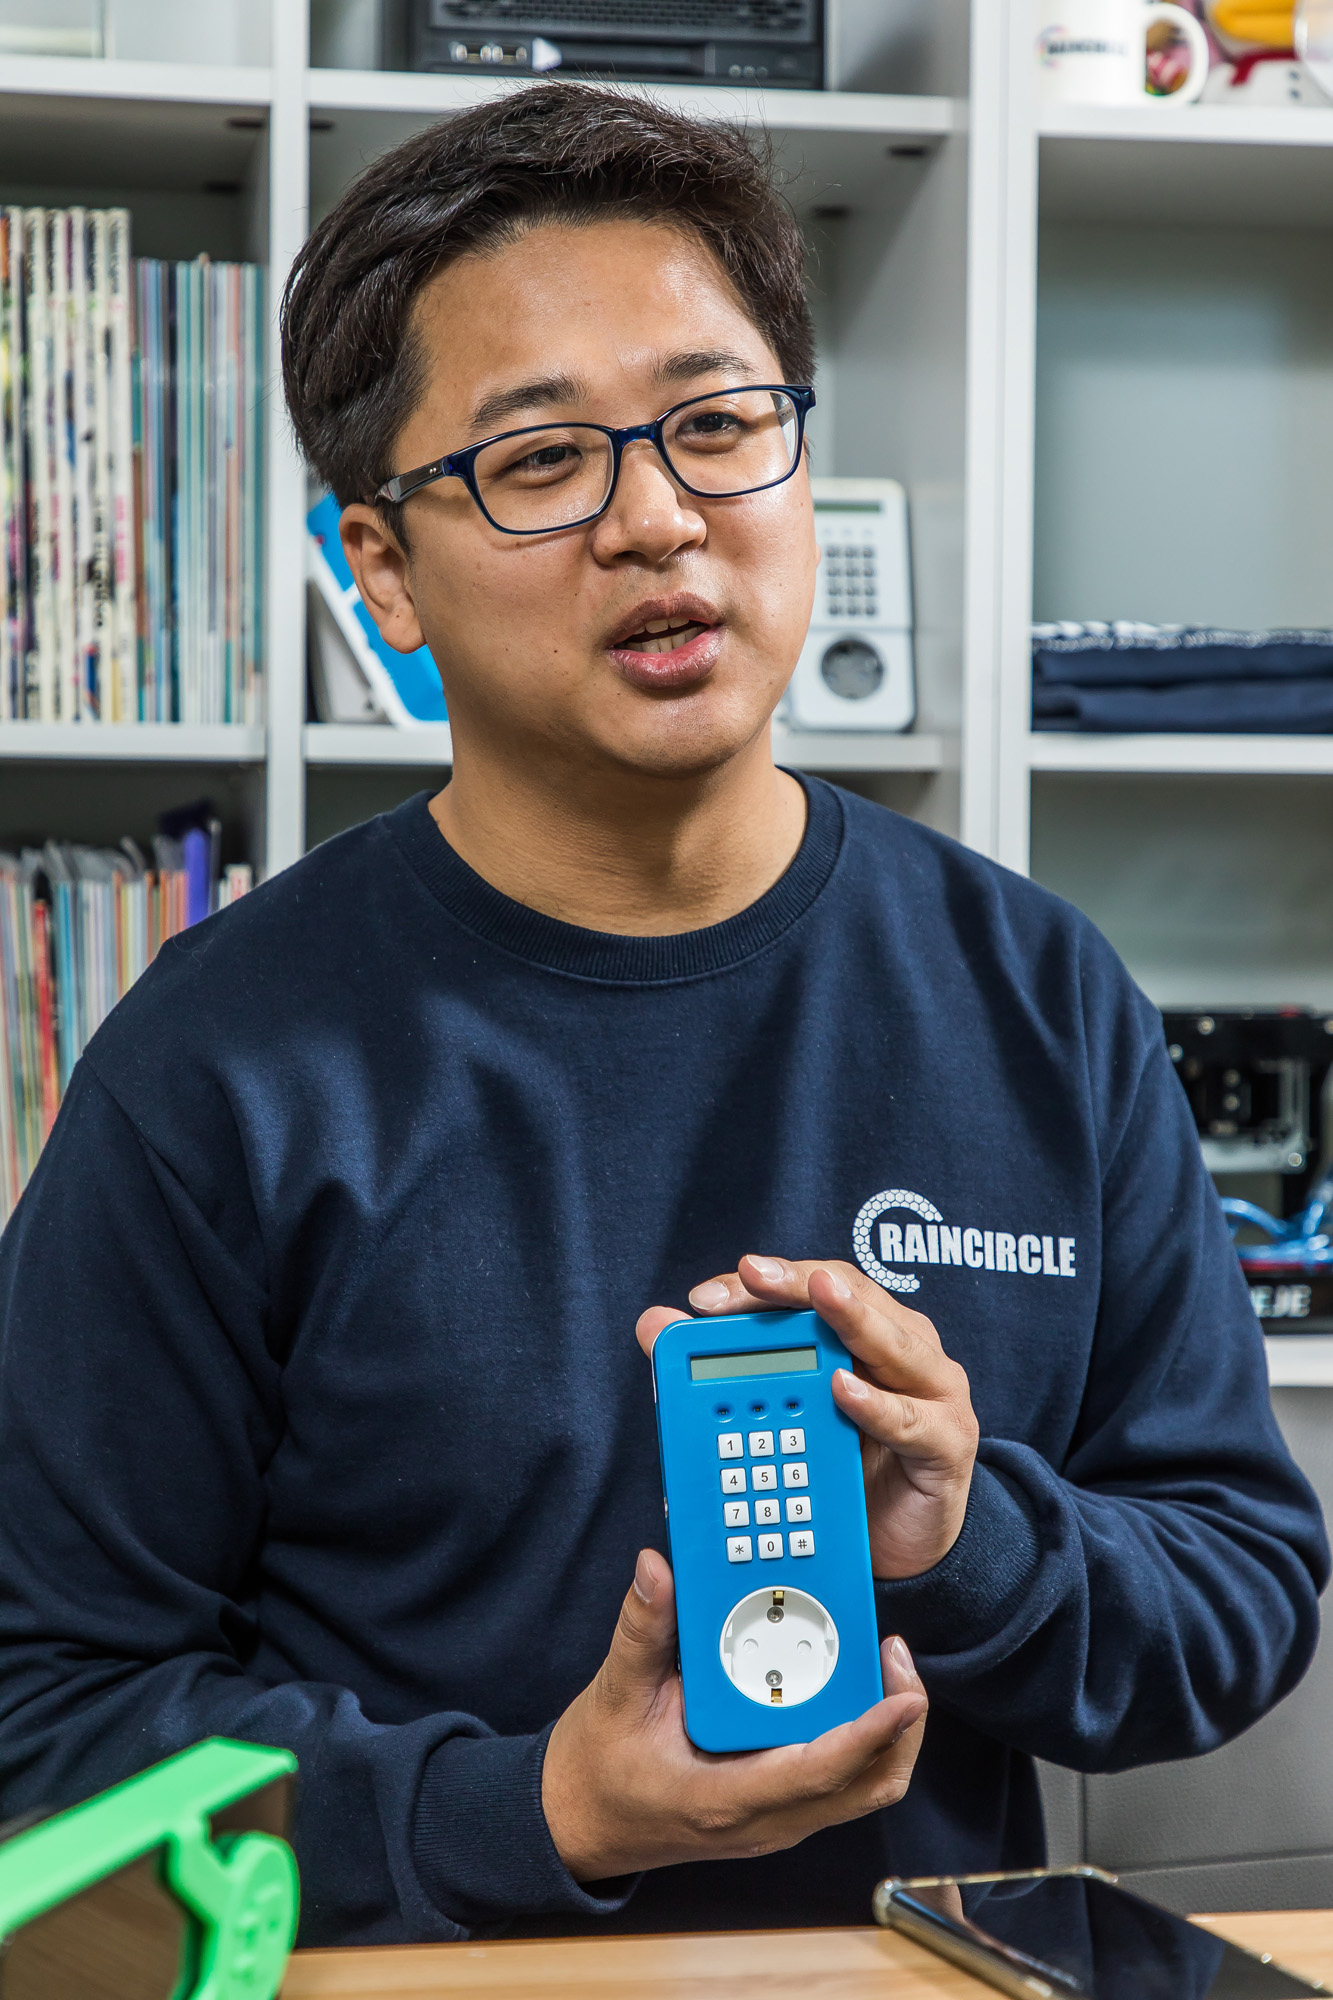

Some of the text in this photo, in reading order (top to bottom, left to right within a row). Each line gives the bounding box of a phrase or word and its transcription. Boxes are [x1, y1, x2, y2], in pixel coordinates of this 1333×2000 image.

[879, 1223, 1076, 1277] RAINCIRCLE
[1250, 1284, 1312, 1318] EJE
[727, 1435, 797, 1451] 1 2 3
[730, 1469, 800, 1486] 4 5 6
[732, 1504, 803, 1519] 7 8 9
[767, 1541, 775, 1552] 0
